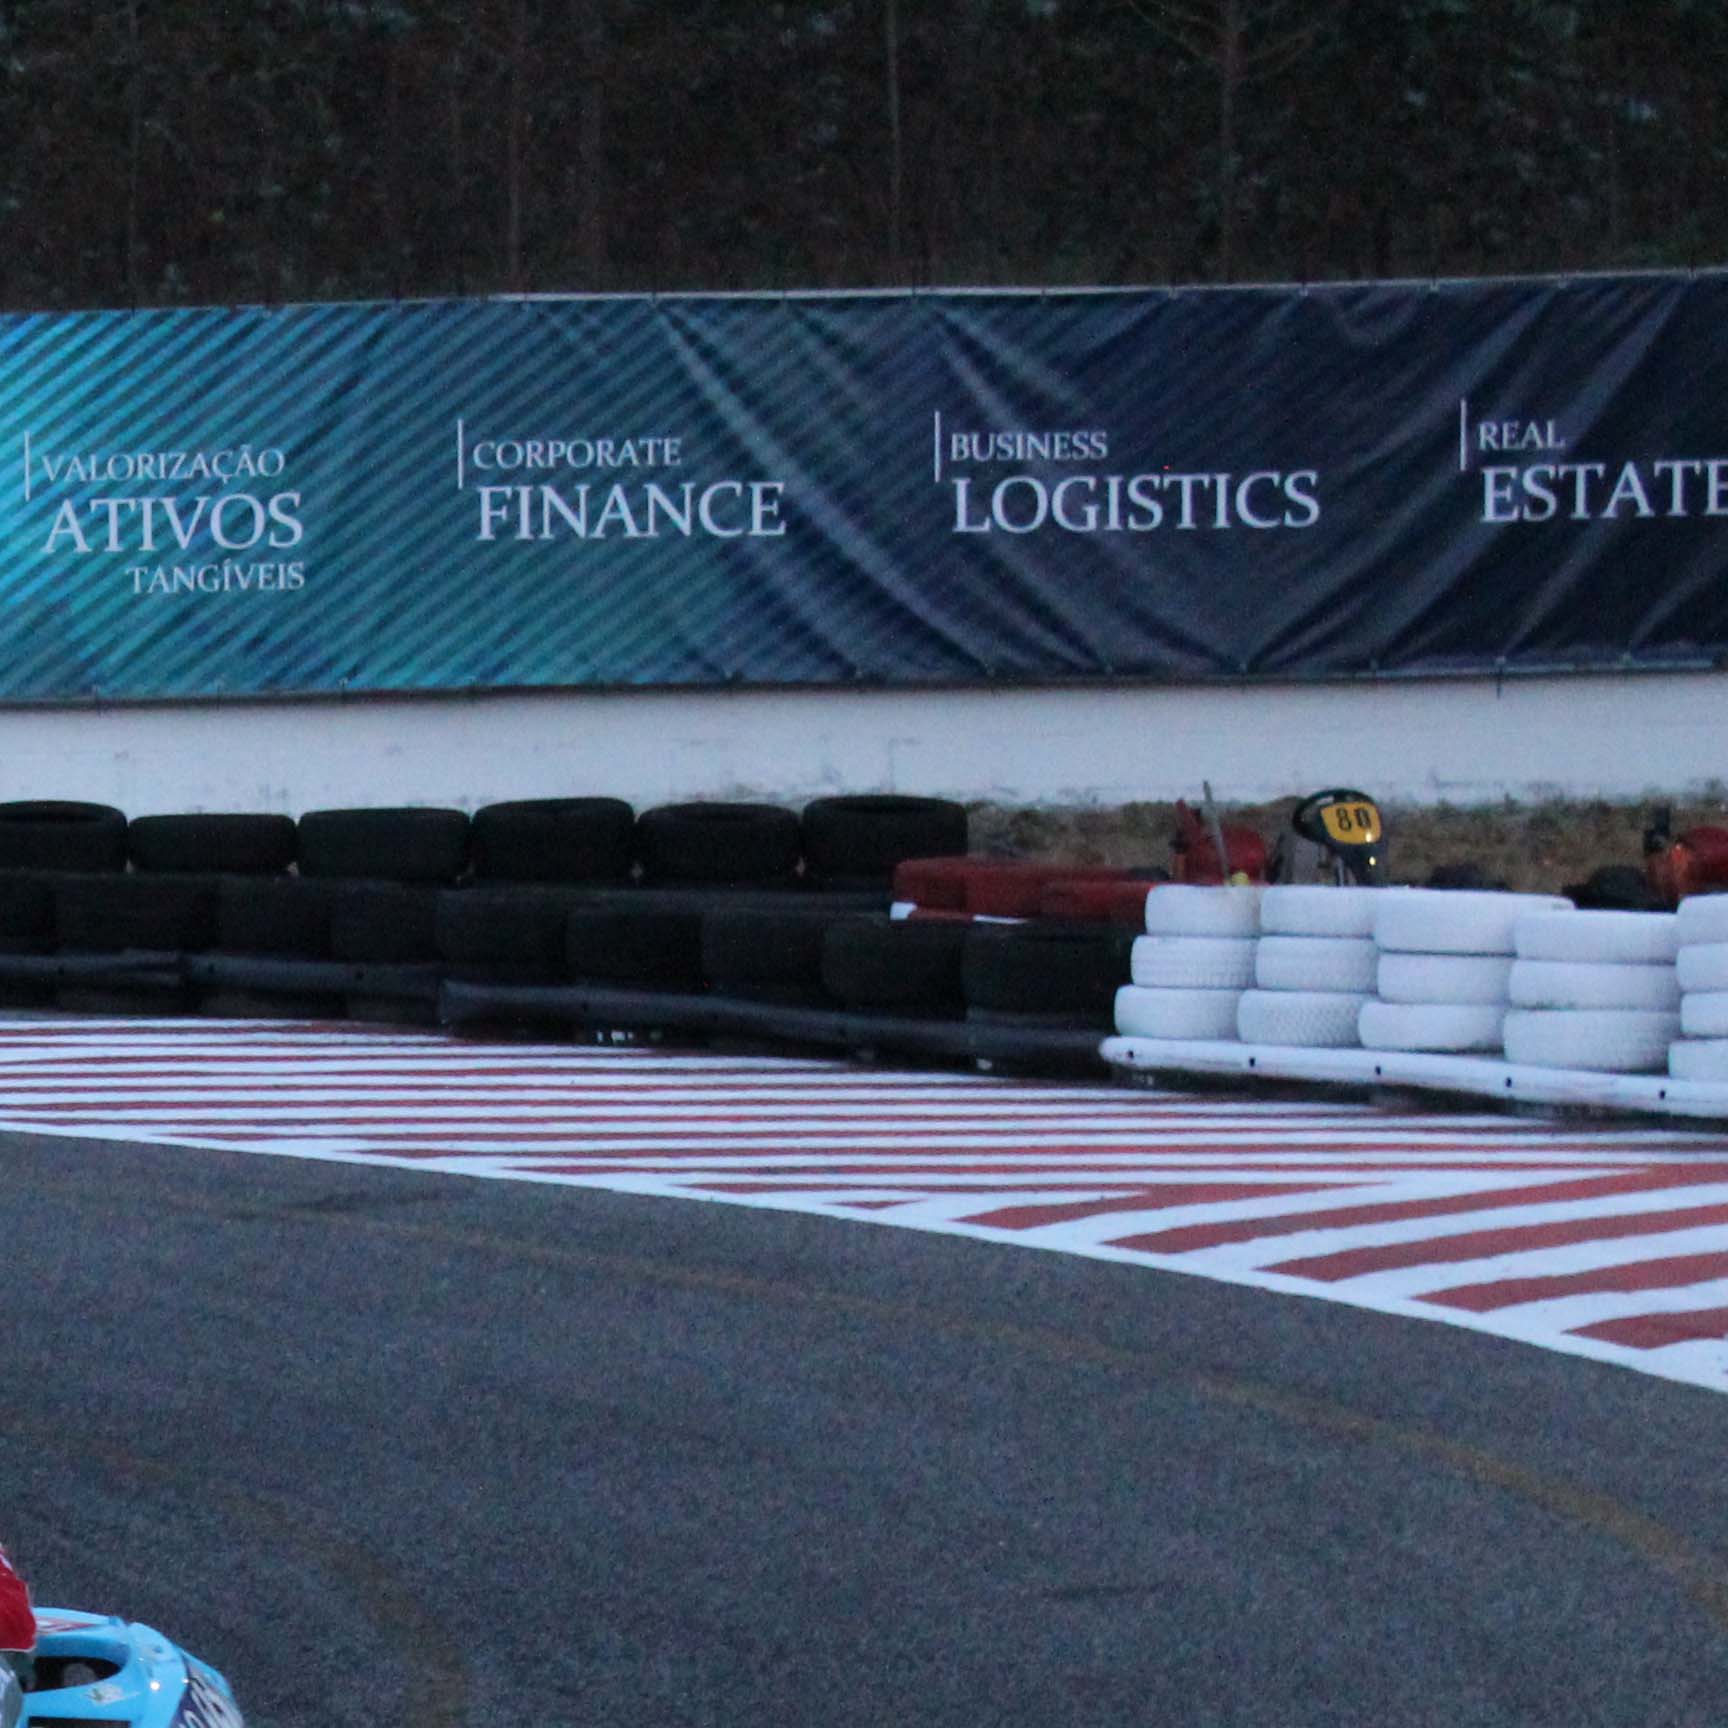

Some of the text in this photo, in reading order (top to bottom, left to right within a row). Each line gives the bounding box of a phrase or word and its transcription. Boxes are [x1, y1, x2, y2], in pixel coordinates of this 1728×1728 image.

[473, 436, 682, 471] CORPORATE
[950, 430, 1108, 463] BUSINESS
[1477, 420, 1566, 452] REAL
[40, 443, 286, 485] VALORIZAÇÃO
[475, 480, 787, 542] FINANCE
[952, 470, 1321, 534] LOGISTICS
[40, 491, 305, 555] ATIVOS
[125, 557, 306, 596] TANGÍVEIS
